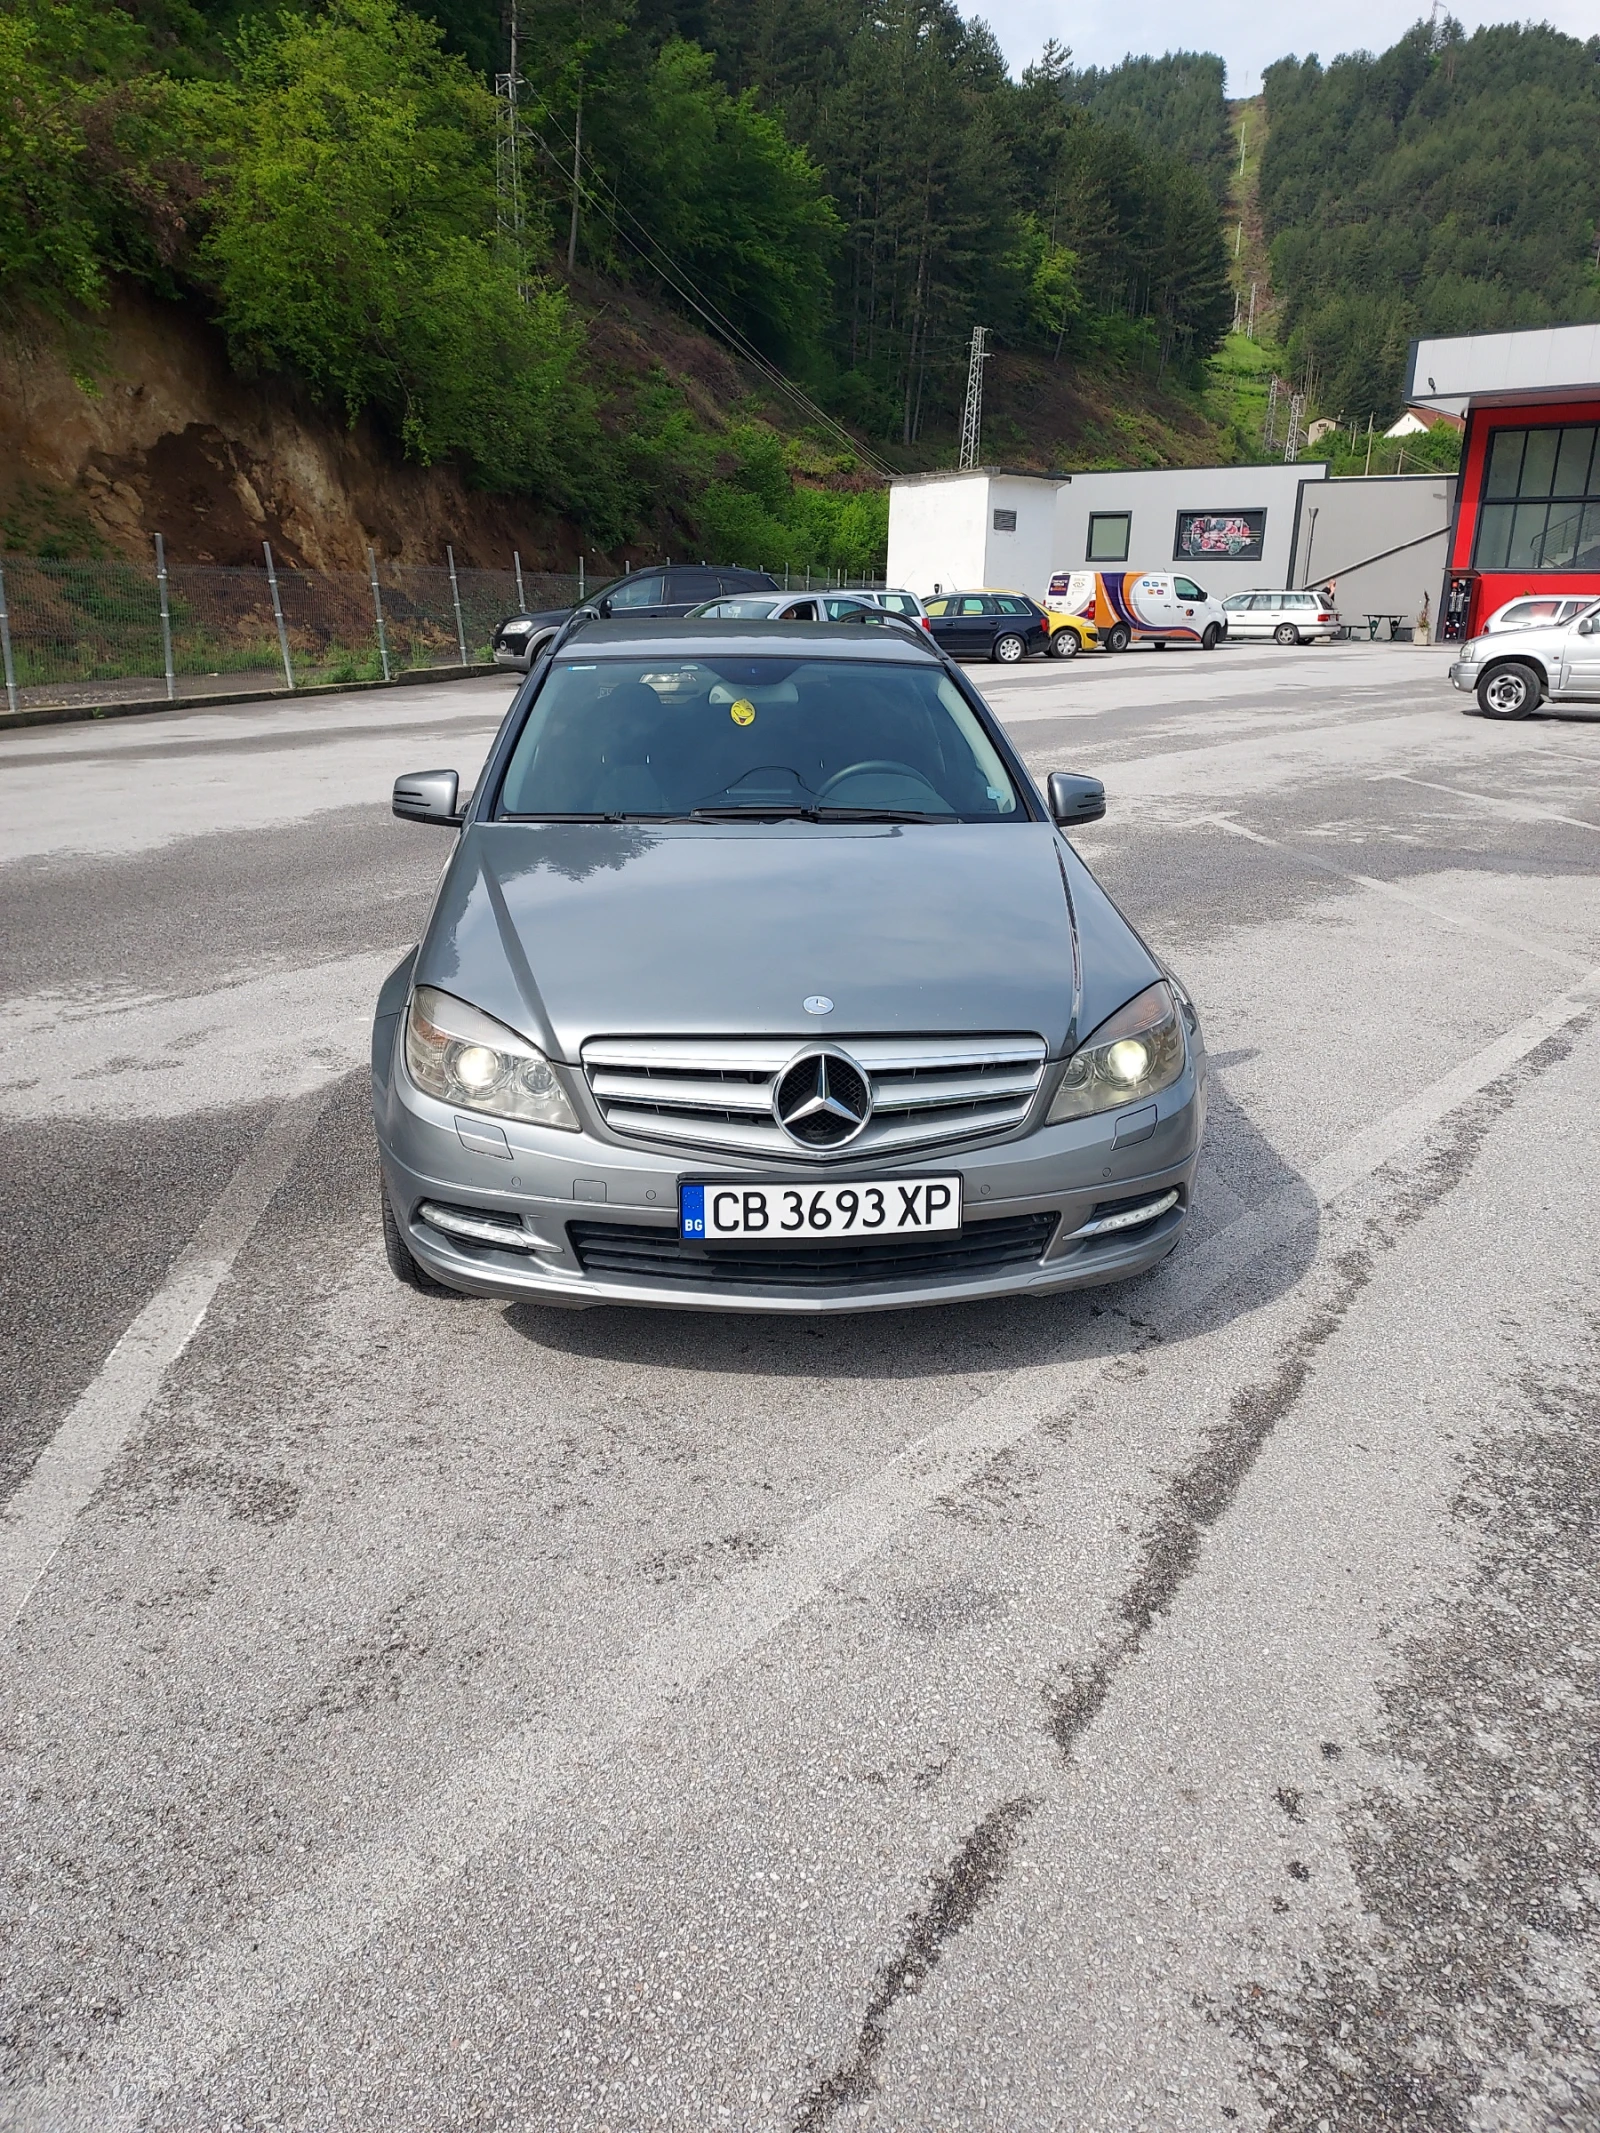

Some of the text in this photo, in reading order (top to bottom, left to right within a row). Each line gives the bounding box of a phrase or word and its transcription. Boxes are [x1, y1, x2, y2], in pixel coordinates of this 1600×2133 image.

[713, 1184, 951, 1232] CB 3693 XP
[684, 1219, 703, 1232] BG
